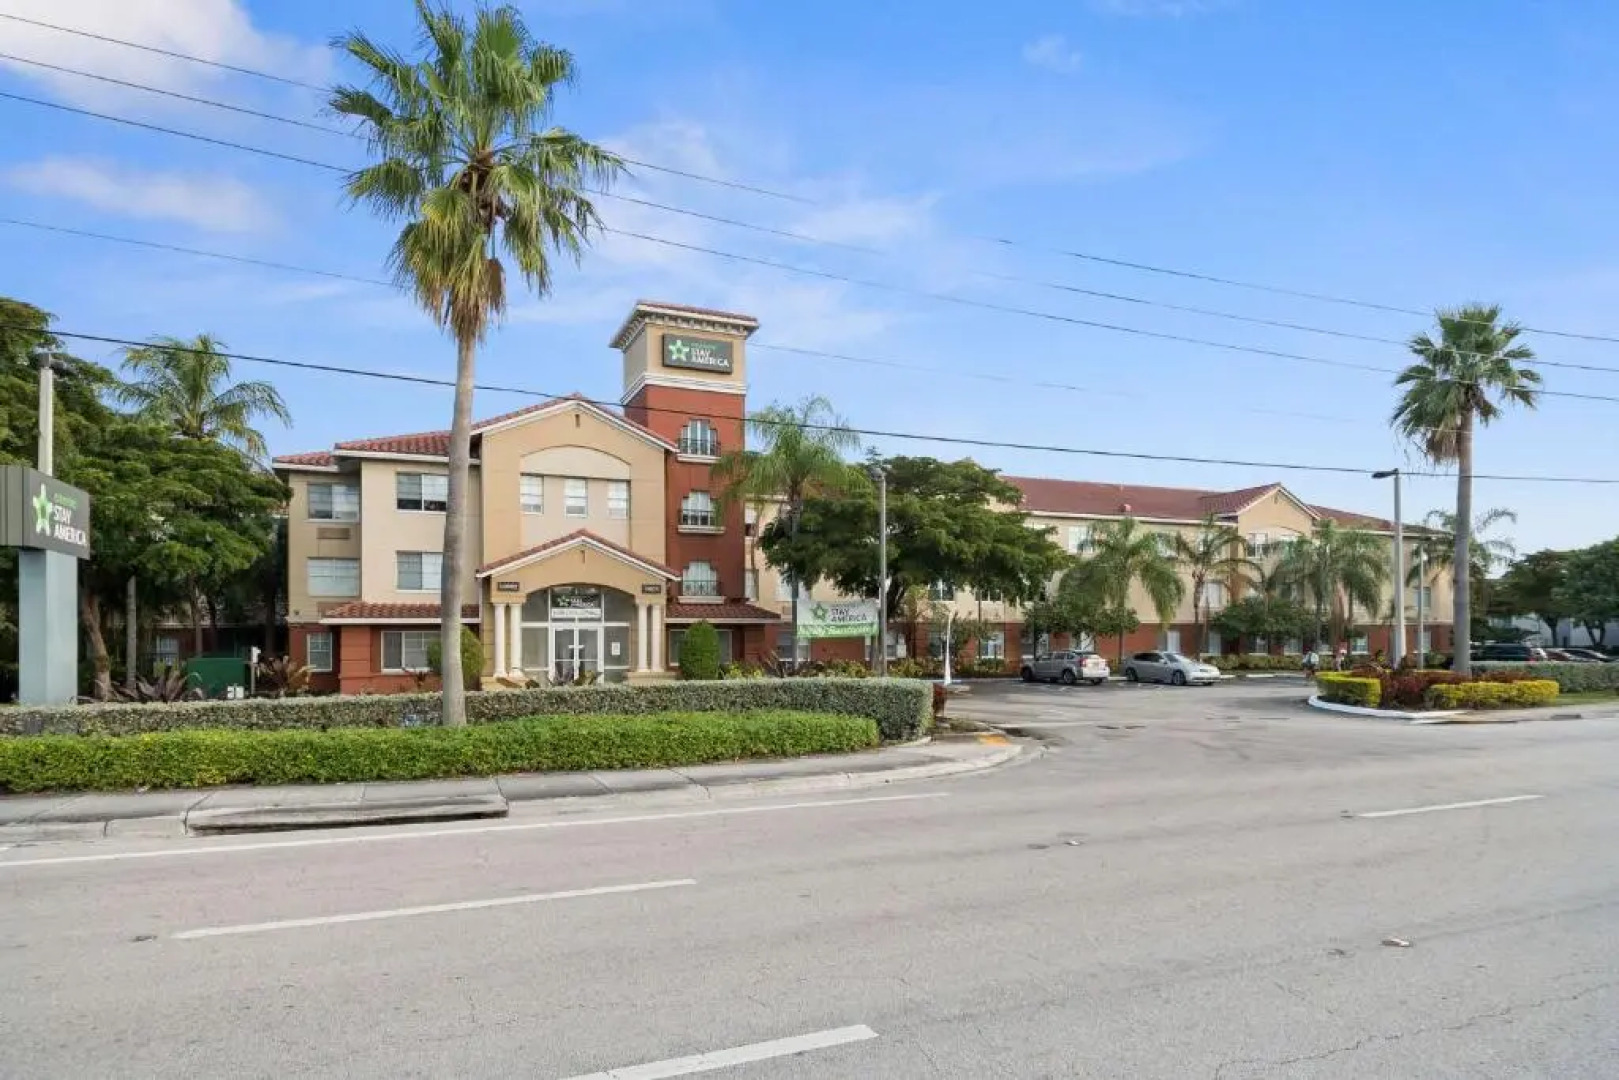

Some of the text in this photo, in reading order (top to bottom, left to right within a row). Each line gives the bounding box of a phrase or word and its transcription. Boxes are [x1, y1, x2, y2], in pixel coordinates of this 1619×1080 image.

[691, 354, 730, 367] AMERICA
[53, 504, 72, 525] STAY
[831, 608, 850, 616] STAY
